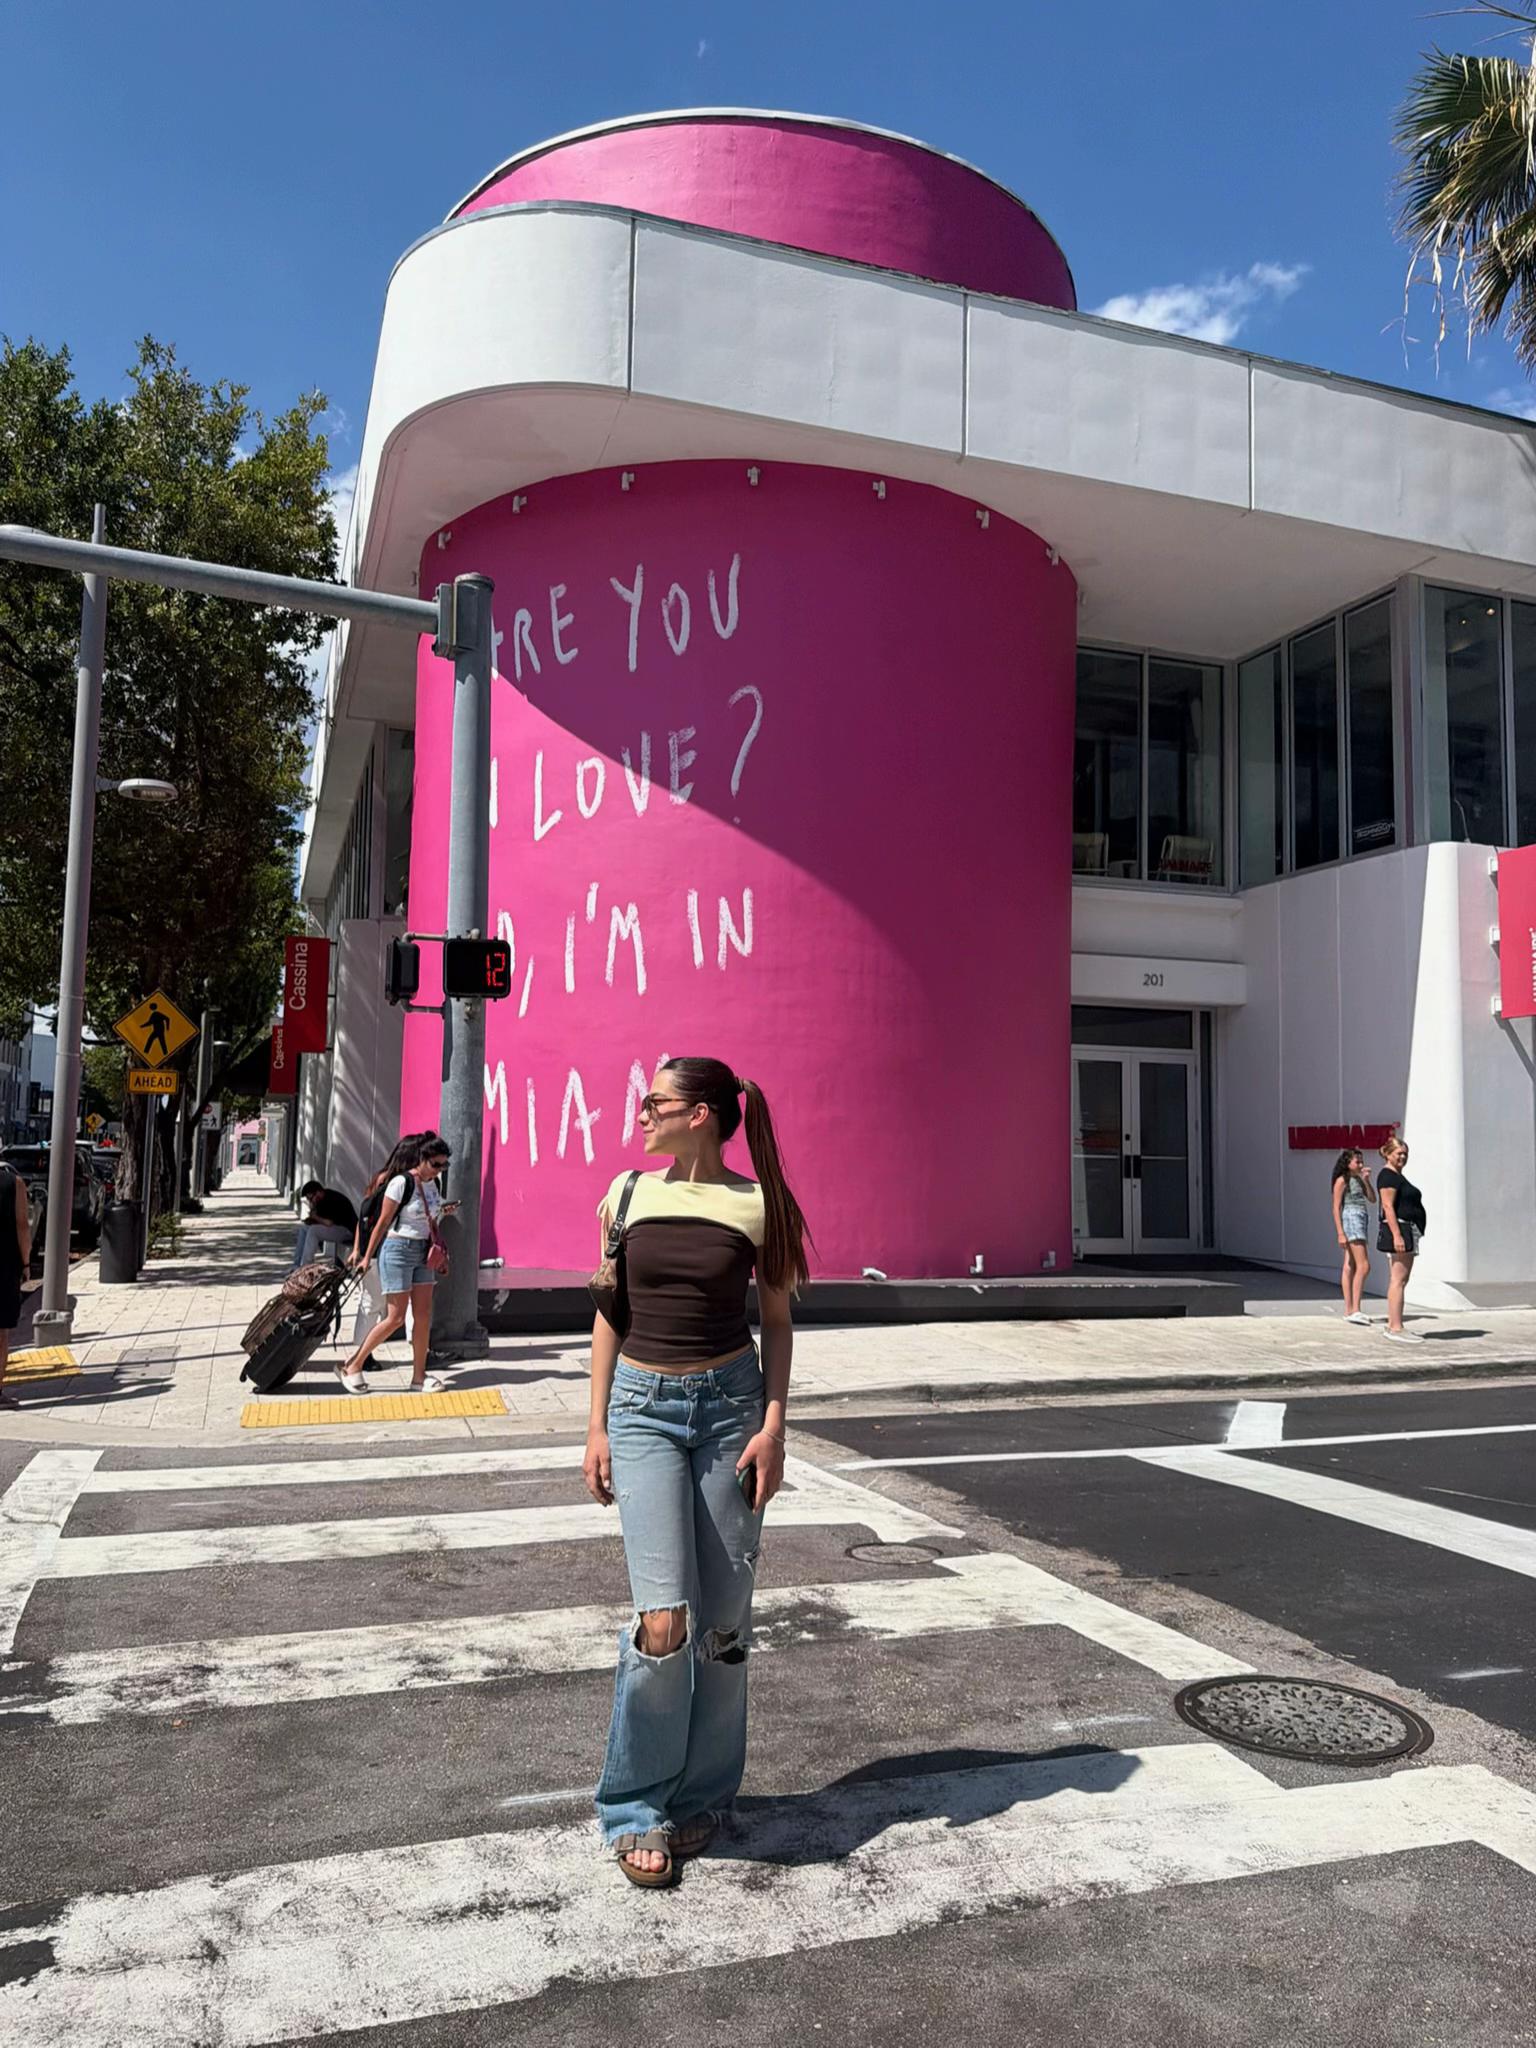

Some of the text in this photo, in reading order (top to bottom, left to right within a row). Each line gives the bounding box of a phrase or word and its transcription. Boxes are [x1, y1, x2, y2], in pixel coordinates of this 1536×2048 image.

[609, 553, 740, 673] YOU
[564, 881, 647, 996] I'M
[687, 887, 753, 971] IN
[289, 942, 309, 1011] Cassina
[486, 952, 505, 988] 12
[1143, 973, 1164, 987] 201
[134, 1076, 172, 1088] AHEAD
